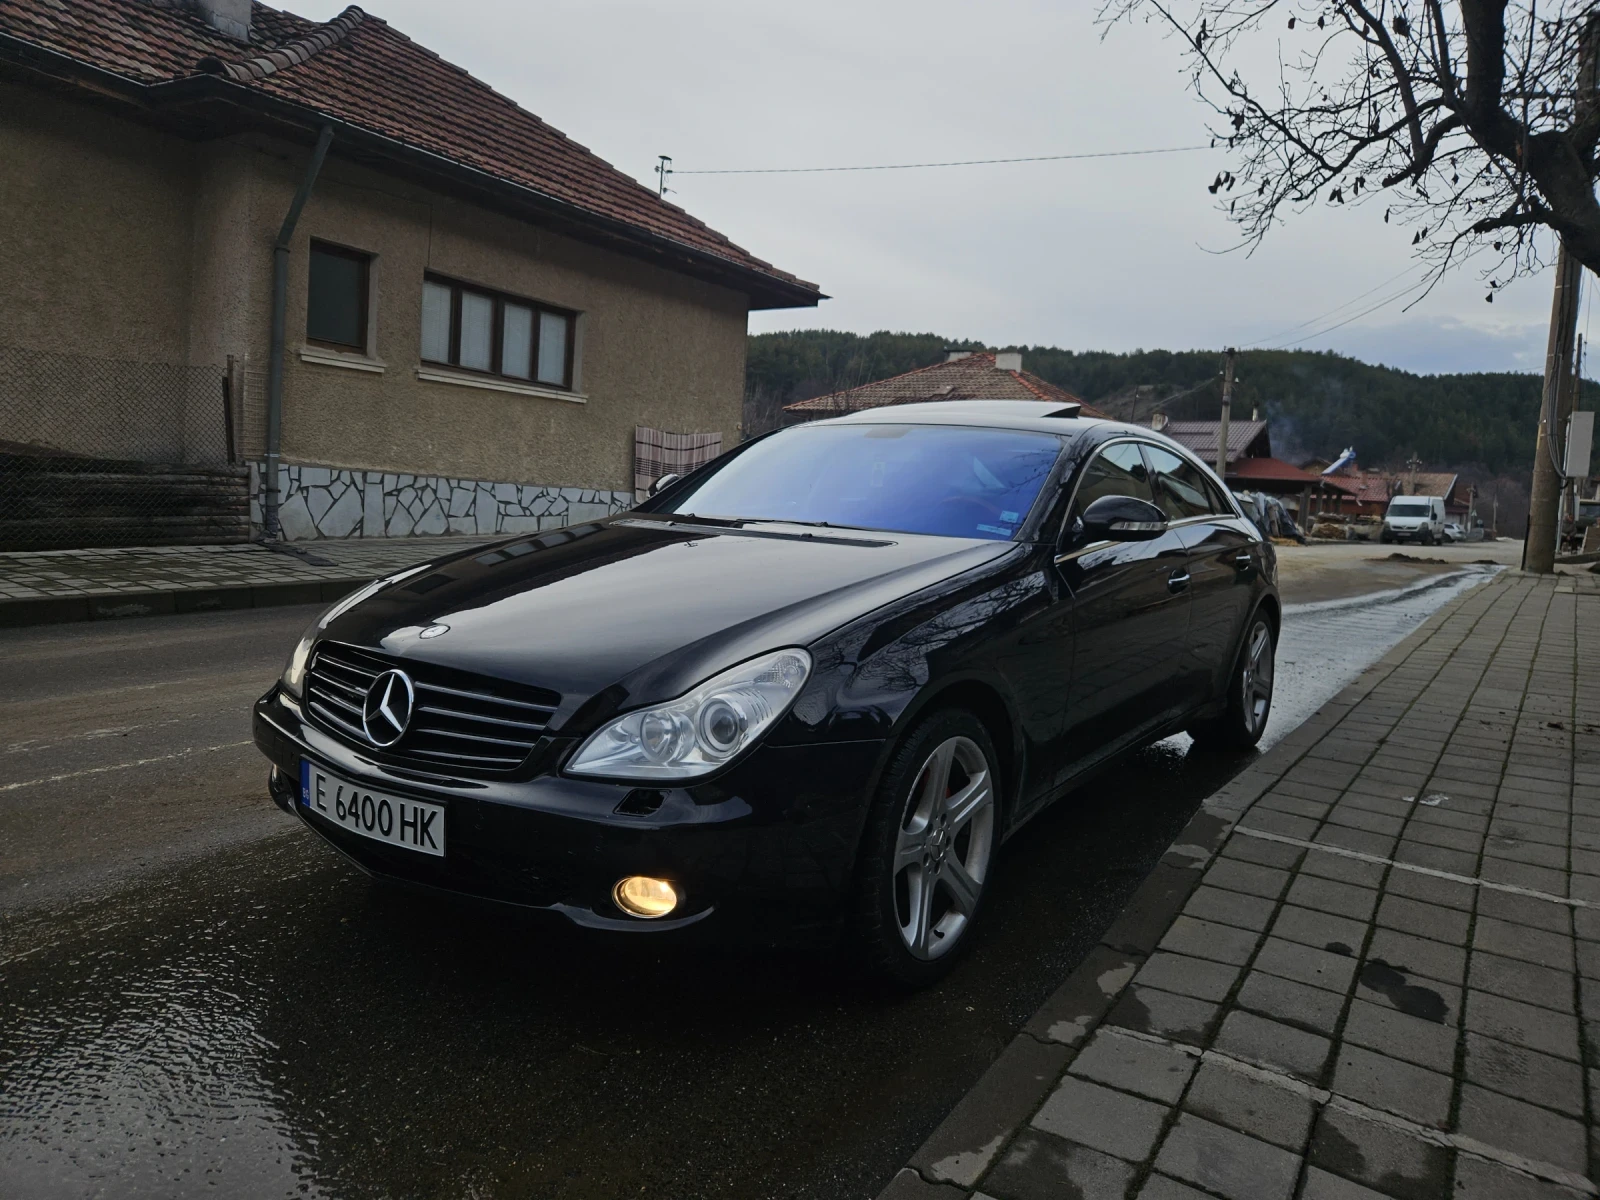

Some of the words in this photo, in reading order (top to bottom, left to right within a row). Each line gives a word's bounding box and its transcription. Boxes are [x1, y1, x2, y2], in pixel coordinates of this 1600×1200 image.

[316, 772, 327, 812] E
[336, 784, 393, 837] 6400
[400, 803, 438, 850] HK
